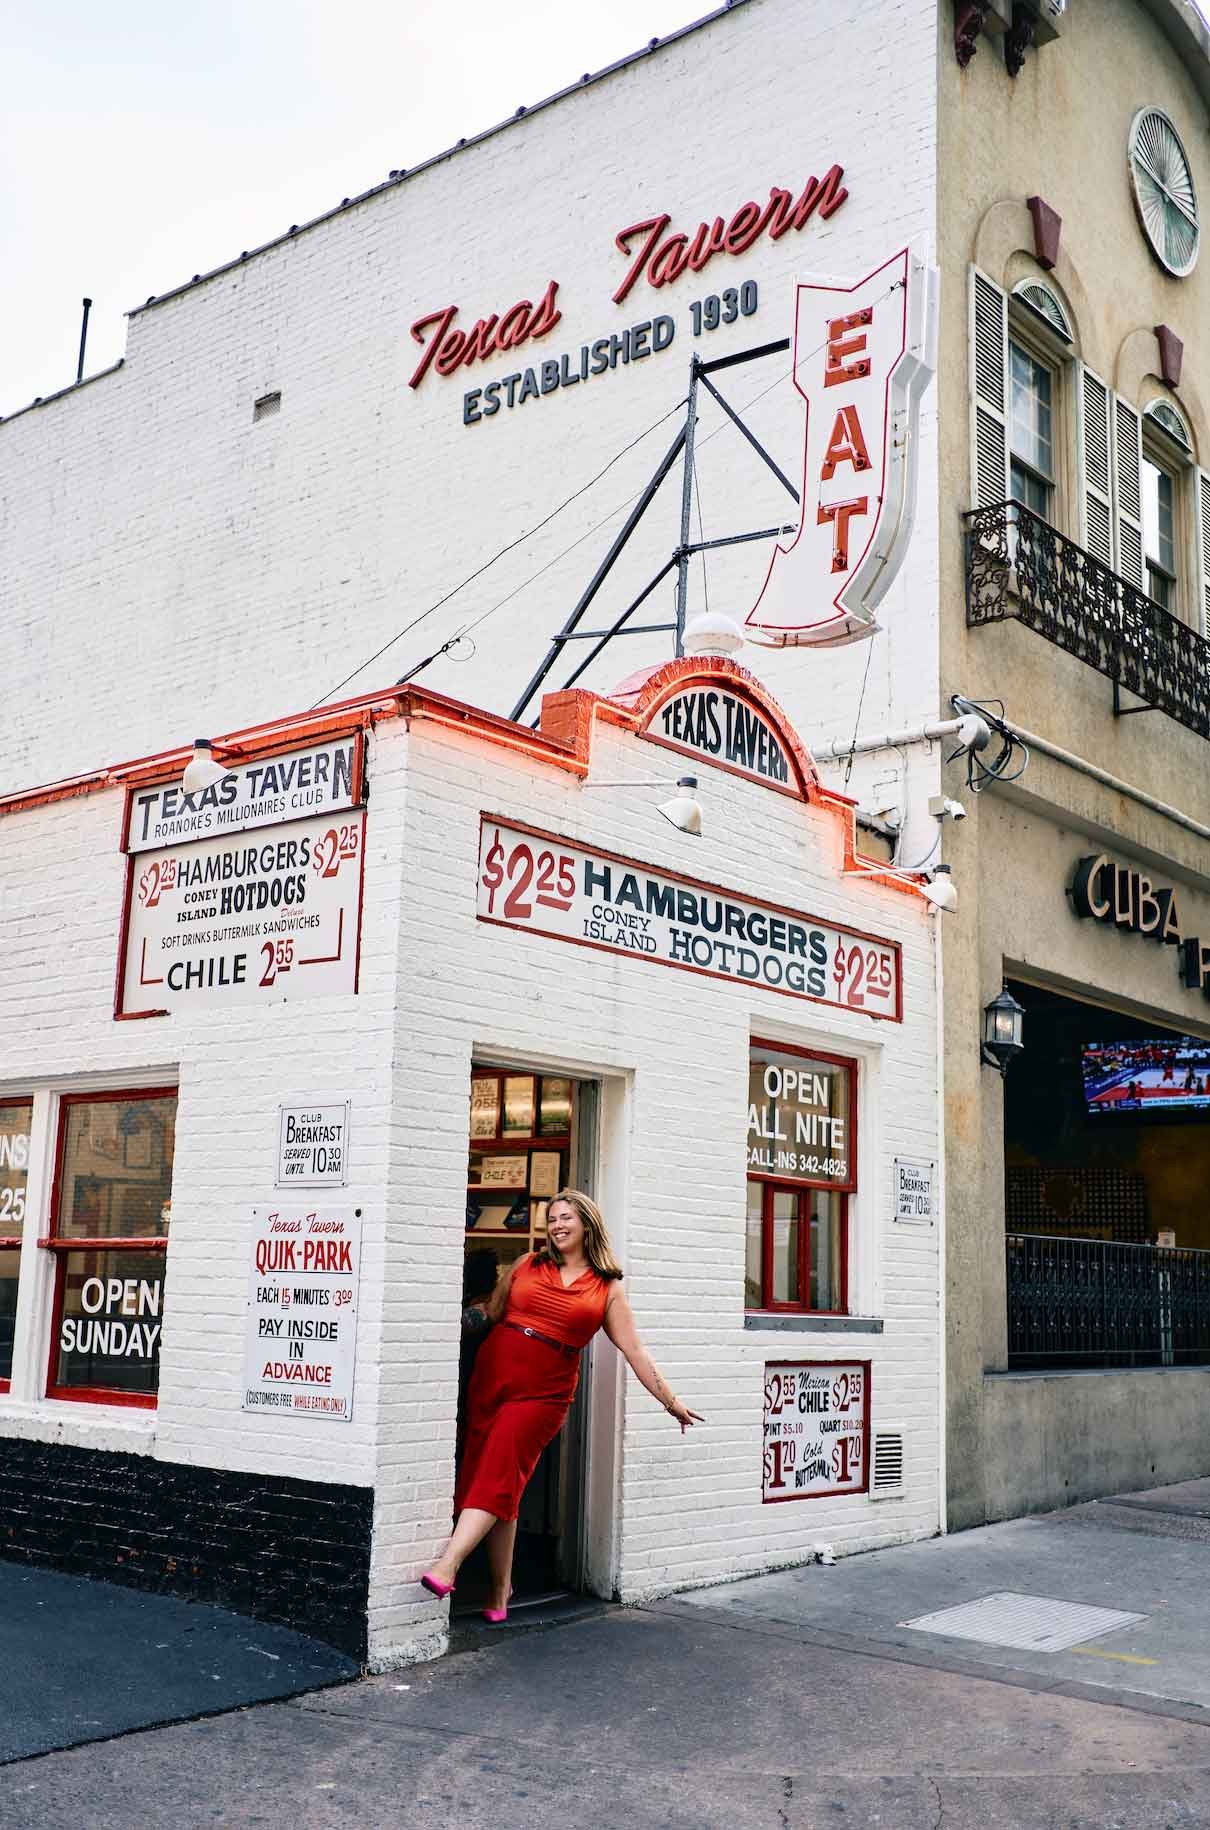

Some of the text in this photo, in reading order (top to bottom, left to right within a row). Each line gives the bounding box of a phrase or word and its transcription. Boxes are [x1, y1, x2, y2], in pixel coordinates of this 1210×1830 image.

[612, 164, 848, 304] Tavern
[408, 281, 561, 389] Texas
[463, 280, 758, 424] ESTABLISHED 1930
[817, 306, 873, 573] EAT
[662, 692, 788, 782] TEXAS TAVERN
[138, 746, 354, 841] TEXAS TAVERN
[155, 789, 323, 838] ROANOKE'S MILLIONAIRES CLUB
[177, 838, 310, 888] HAMBURGERS
[184, 874, 306, 915] CONEY HOTDOGS
[1086, 854, 1184, 944] CUBA
[176, 907, 217, 922] ISLAND
[583, 860, 826, 965] HAMBURGERS
[592, 904, 651, 931] CONEY
[161, 915, 320, 949] SOFT DRINKS BUTTERMILK SANDWICHES
[167, 953, 247, 991] CHILE
[583, 920, 826, 997] ISLAND HOTDOGS
[764, 1065, 828, 1107] OPEN
[286, 1115, 342, 1143] BREAKFAST
[301, 1113, 322, 1123] CLUB
[748, 1103, 844, 1150] ALL NITE
[0, 1134, 29, 1169] NS
[284, 1148, 311, 1160] SERVED
[285, 1161, 341, 1174] UNTIL AM
[800, 1155, 847, 1176] 342-4825
[268, 1213, 344, 1234] Texas Tavern
[256, 1239, 352, 1275] QUIK-PARK
[81, 1278, 161, 1316] OPEN
[257, 1287, 279, 1303] EACH
[281, 1288, 290, 1304] 15
[293, 1288, 329, 1305] MINUTES
[60, 1319, 161, 1359] SUNDAY
[259, 1318, 338, 1339] PAY INSIDE
[289, 1342, 304, 1358] IN
[262, 1362, 332, 1382] ADVANCE
[799, 1371, 830, 1390] Mexican
[280, 1393, 292, 1407] FREE
[294, 1394, 310, 1409] WHILE
[311, 1396, 329, 1411] EATING
[799, 1391, 829, 1413] CHILE
[764, 1422, 781, 1436] PINT
[783, 1422, 803, 1434] $5.10
[820, 1420, 841, 1434] QUART
[803, 1441, 823, 1462] Cold
